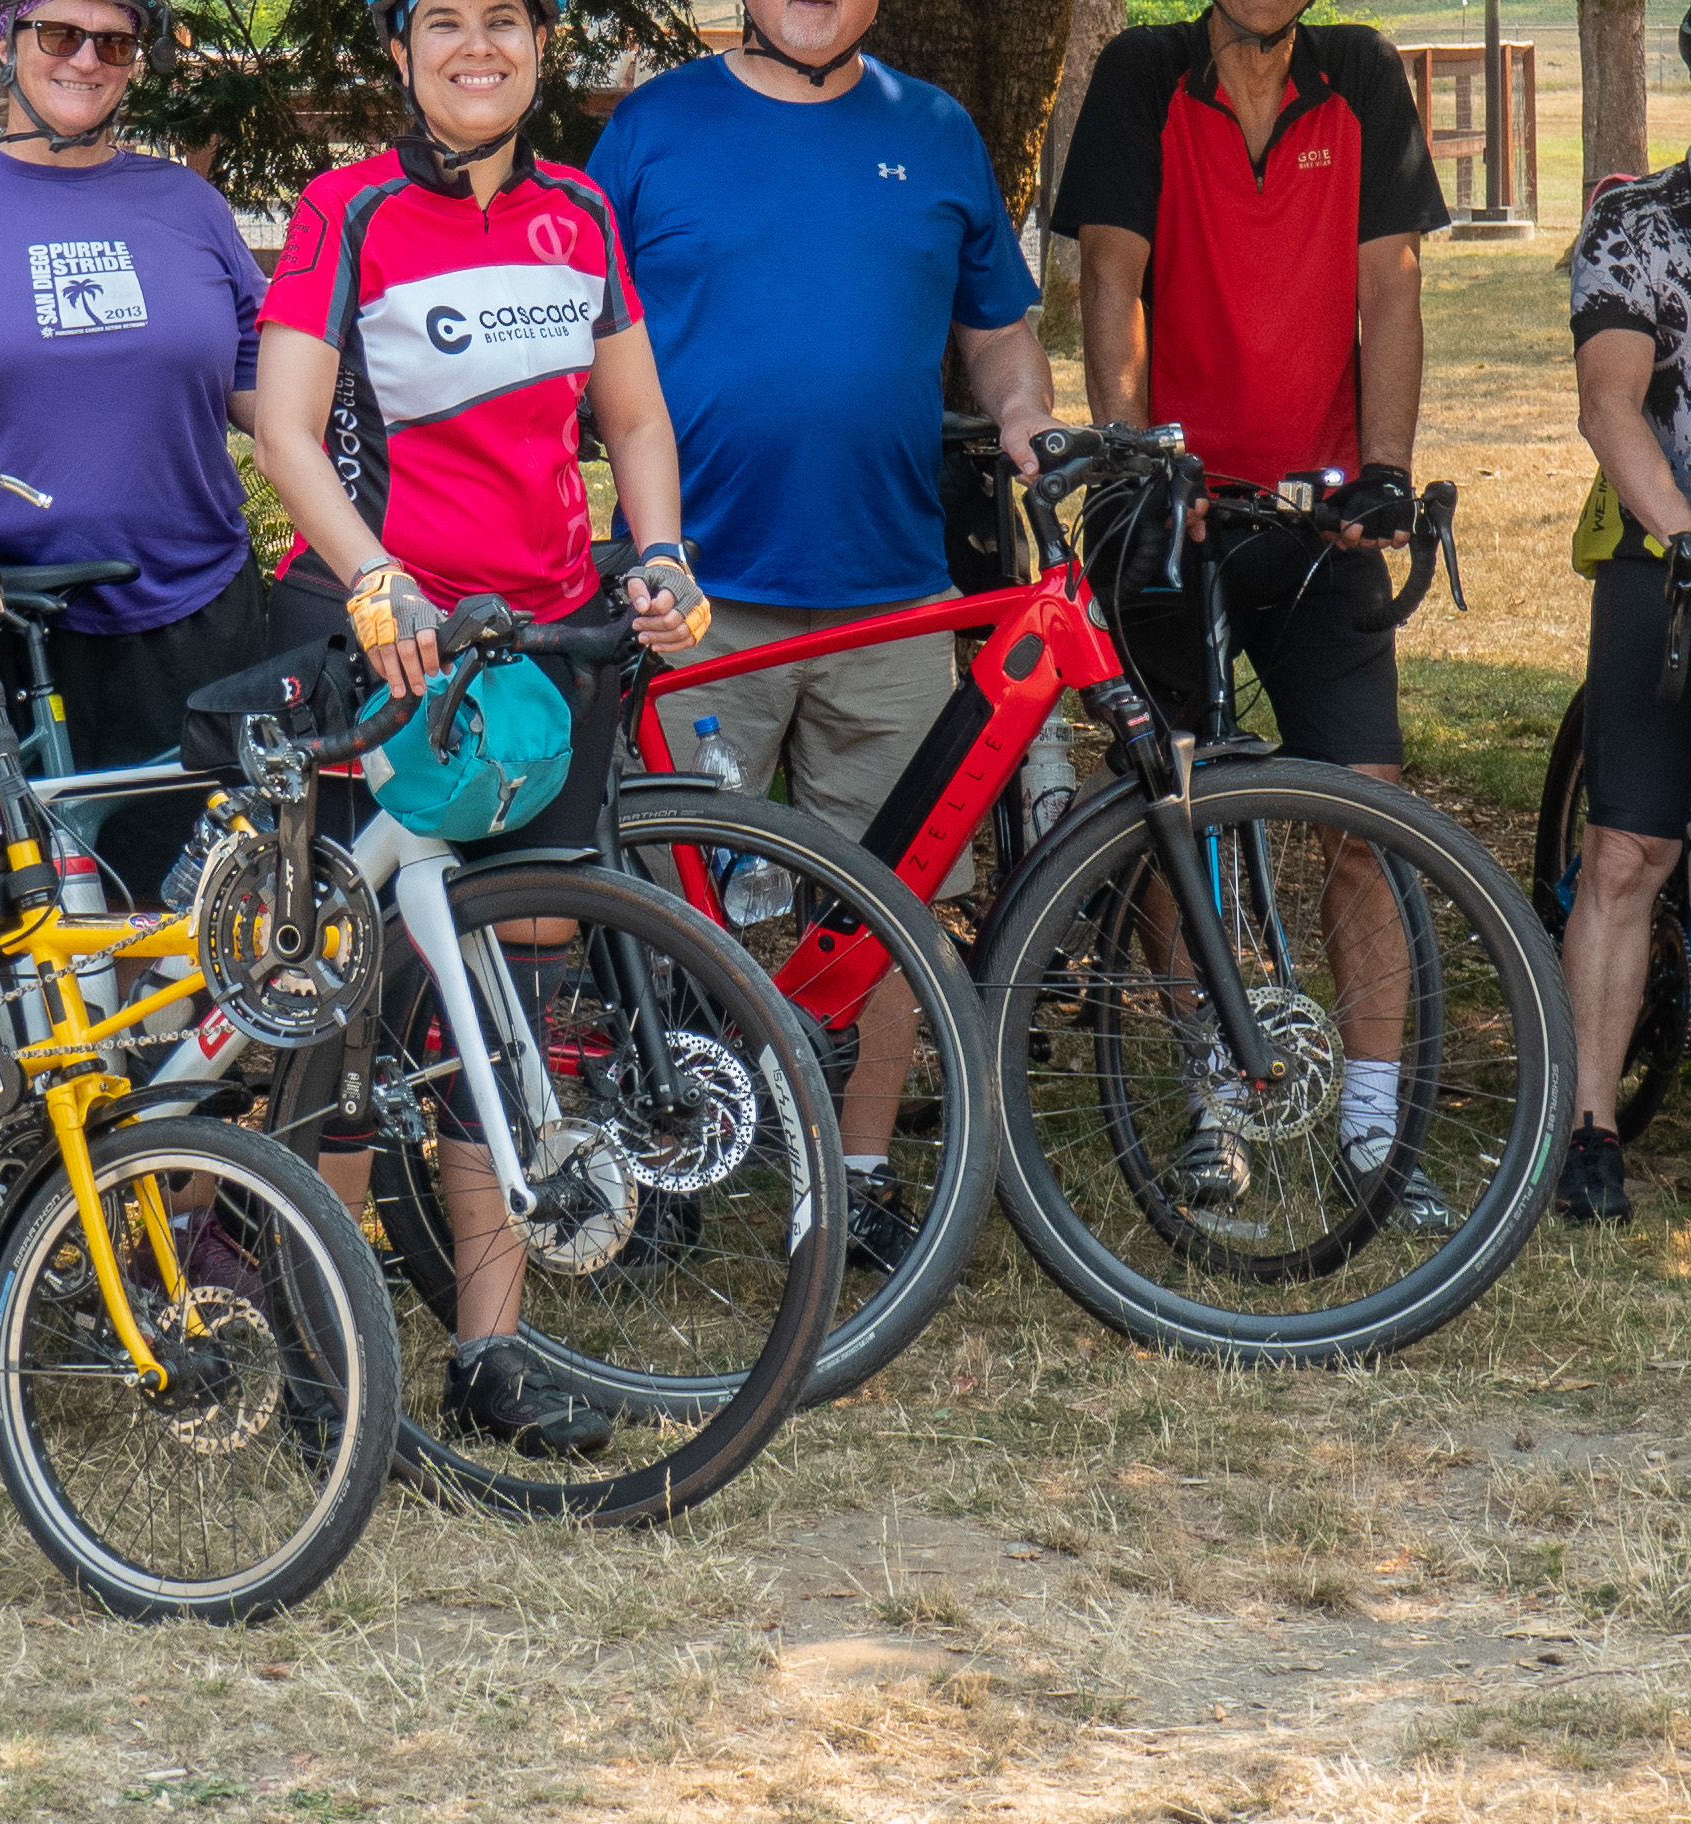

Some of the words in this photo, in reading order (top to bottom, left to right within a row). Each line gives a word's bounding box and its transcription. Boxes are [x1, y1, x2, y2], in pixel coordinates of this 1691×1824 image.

[49, 241, 129, 259] PURPLE
[28, 245, 53, 290] DIEGO
[52, 256, 134, 275] STRIDE
[34, 293, 58, 325] SAN
[105, 306, 142, 320] 2013
[479, 299, 589, 329] cascade
[484, 328, 536, 343] BICYCLE
[540, 326, 570, 339] CLUB
[909, 736, 1003, 872] ZELLE
[13, 1194, 60, 1269] MARATHON
